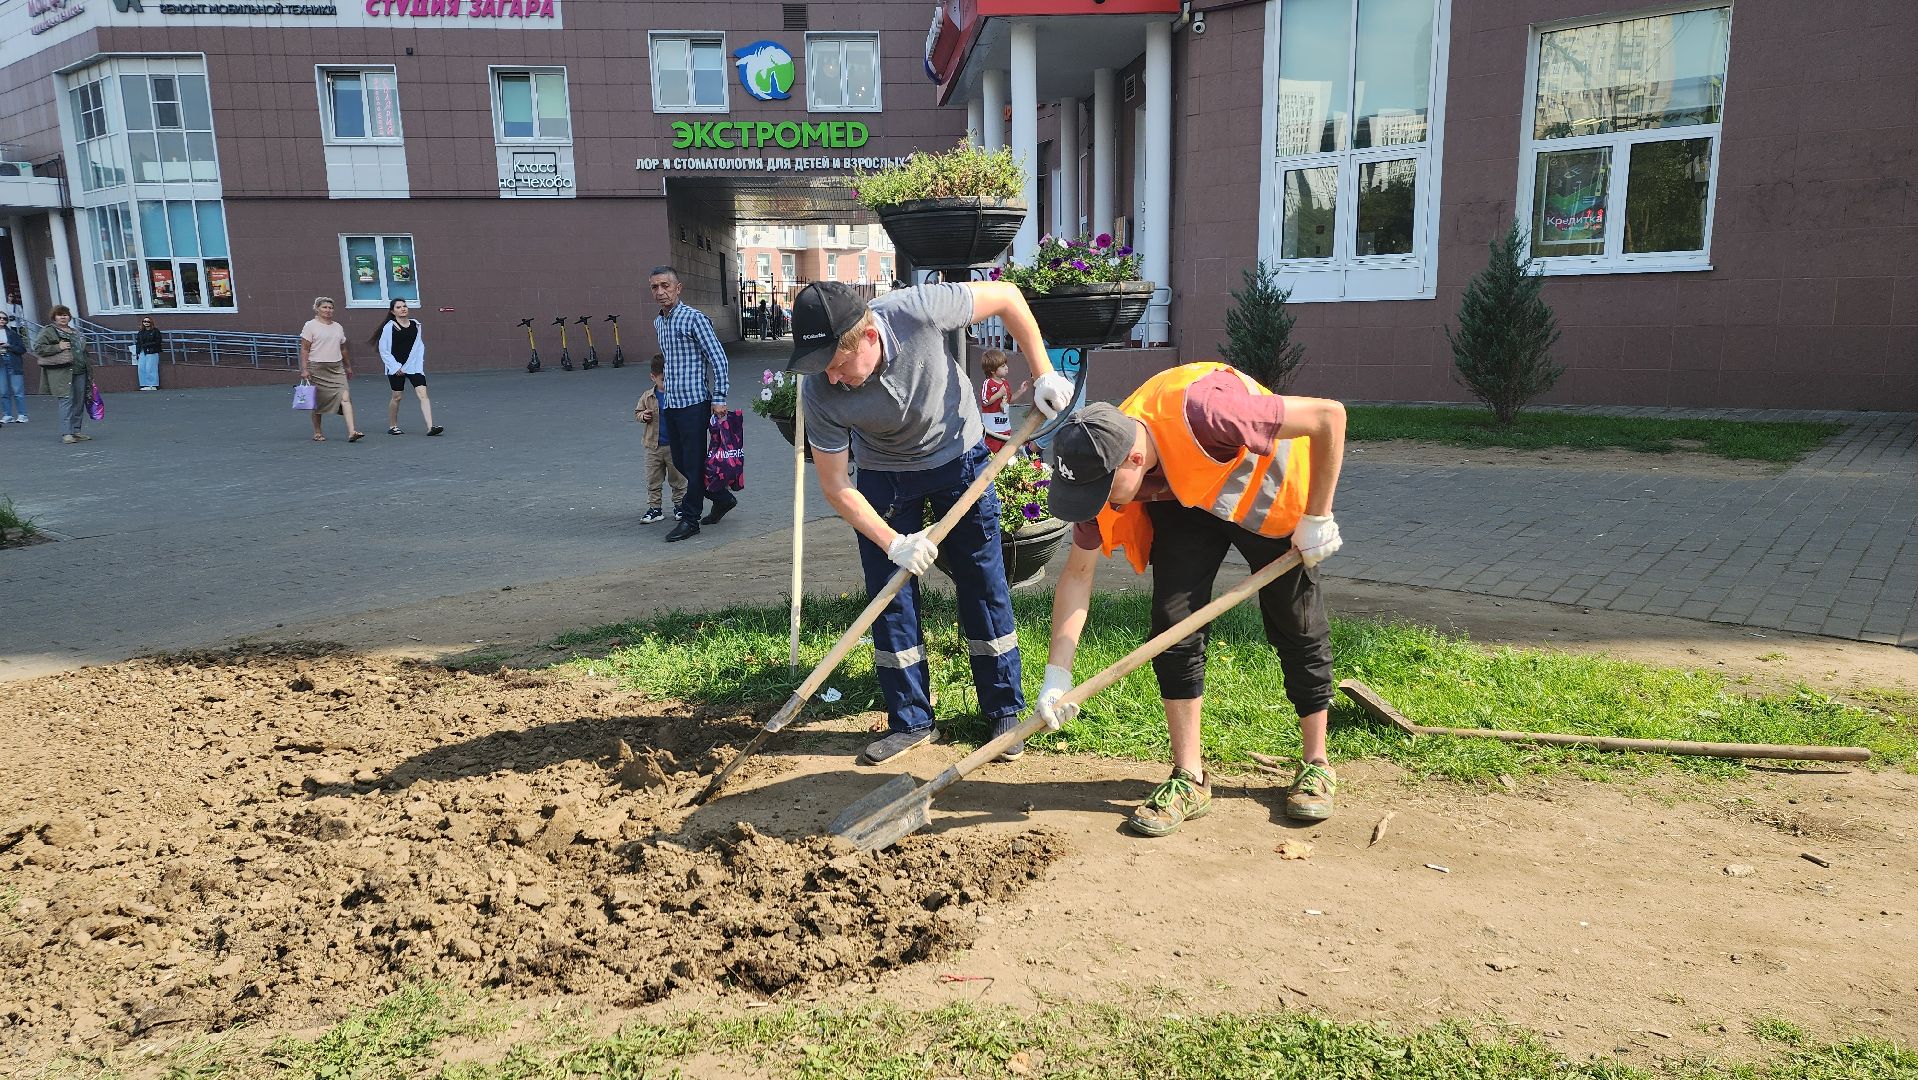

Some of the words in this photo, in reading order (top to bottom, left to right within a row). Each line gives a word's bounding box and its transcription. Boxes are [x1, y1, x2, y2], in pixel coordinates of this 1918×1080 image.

[160, 4, 207, 15] РЕМОНТ
[209, 3, 284, 15] МОБИЛЬНОЙ
[286, 4, 338, 16] ТЕХНИКИ
[366, 0, 461, 17] СТУДИЯ
[469, 0, 554, 18] ЗАГАРА
[514, 160, 556, 173] Класс
[636, 158, 659, 170] ЛОР
[662, 158, 671, 170] И
[674, 157, 763, 170] СТОМАТОЛОГИЯ
[766, 157, 792, 172] ДЛЯ
[795, 155, 830, 171] ДЕТЕЙ
[832, 157, 841, 169] И
[498, 178, 516, 188] на
[521, 175, 573, 188] Чехова
[1546, 215, 1603, 227] Кредитка
[1056, 455, 1076, 481] LA
